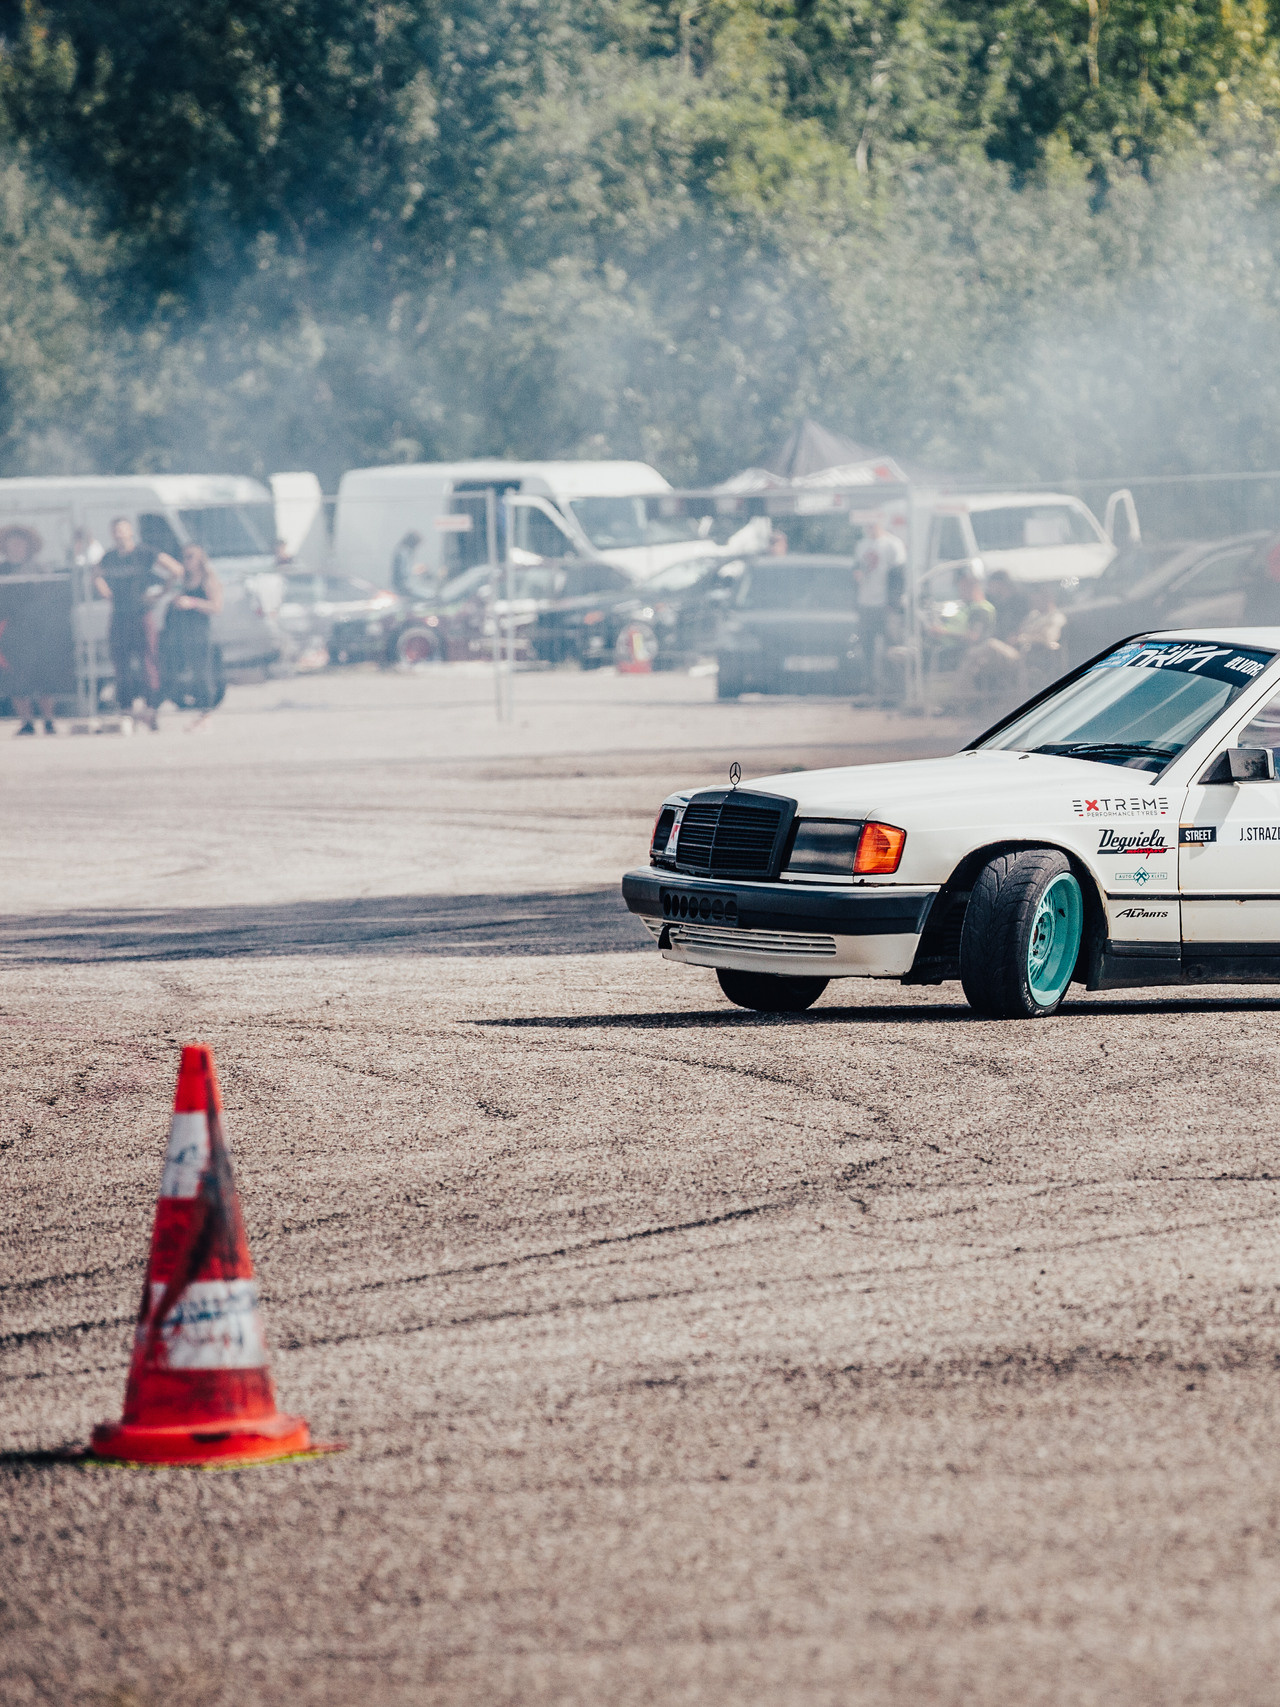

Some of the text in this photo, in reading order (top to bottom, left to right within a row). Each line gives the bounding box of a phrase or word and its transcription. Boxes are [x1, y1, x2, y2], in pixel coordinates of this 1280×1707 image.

[1072, 797, 1169, 812] EXTREME
[1098, 829, 1169, 854] Degviela
[1184, 828, 1213, 842] STREET
